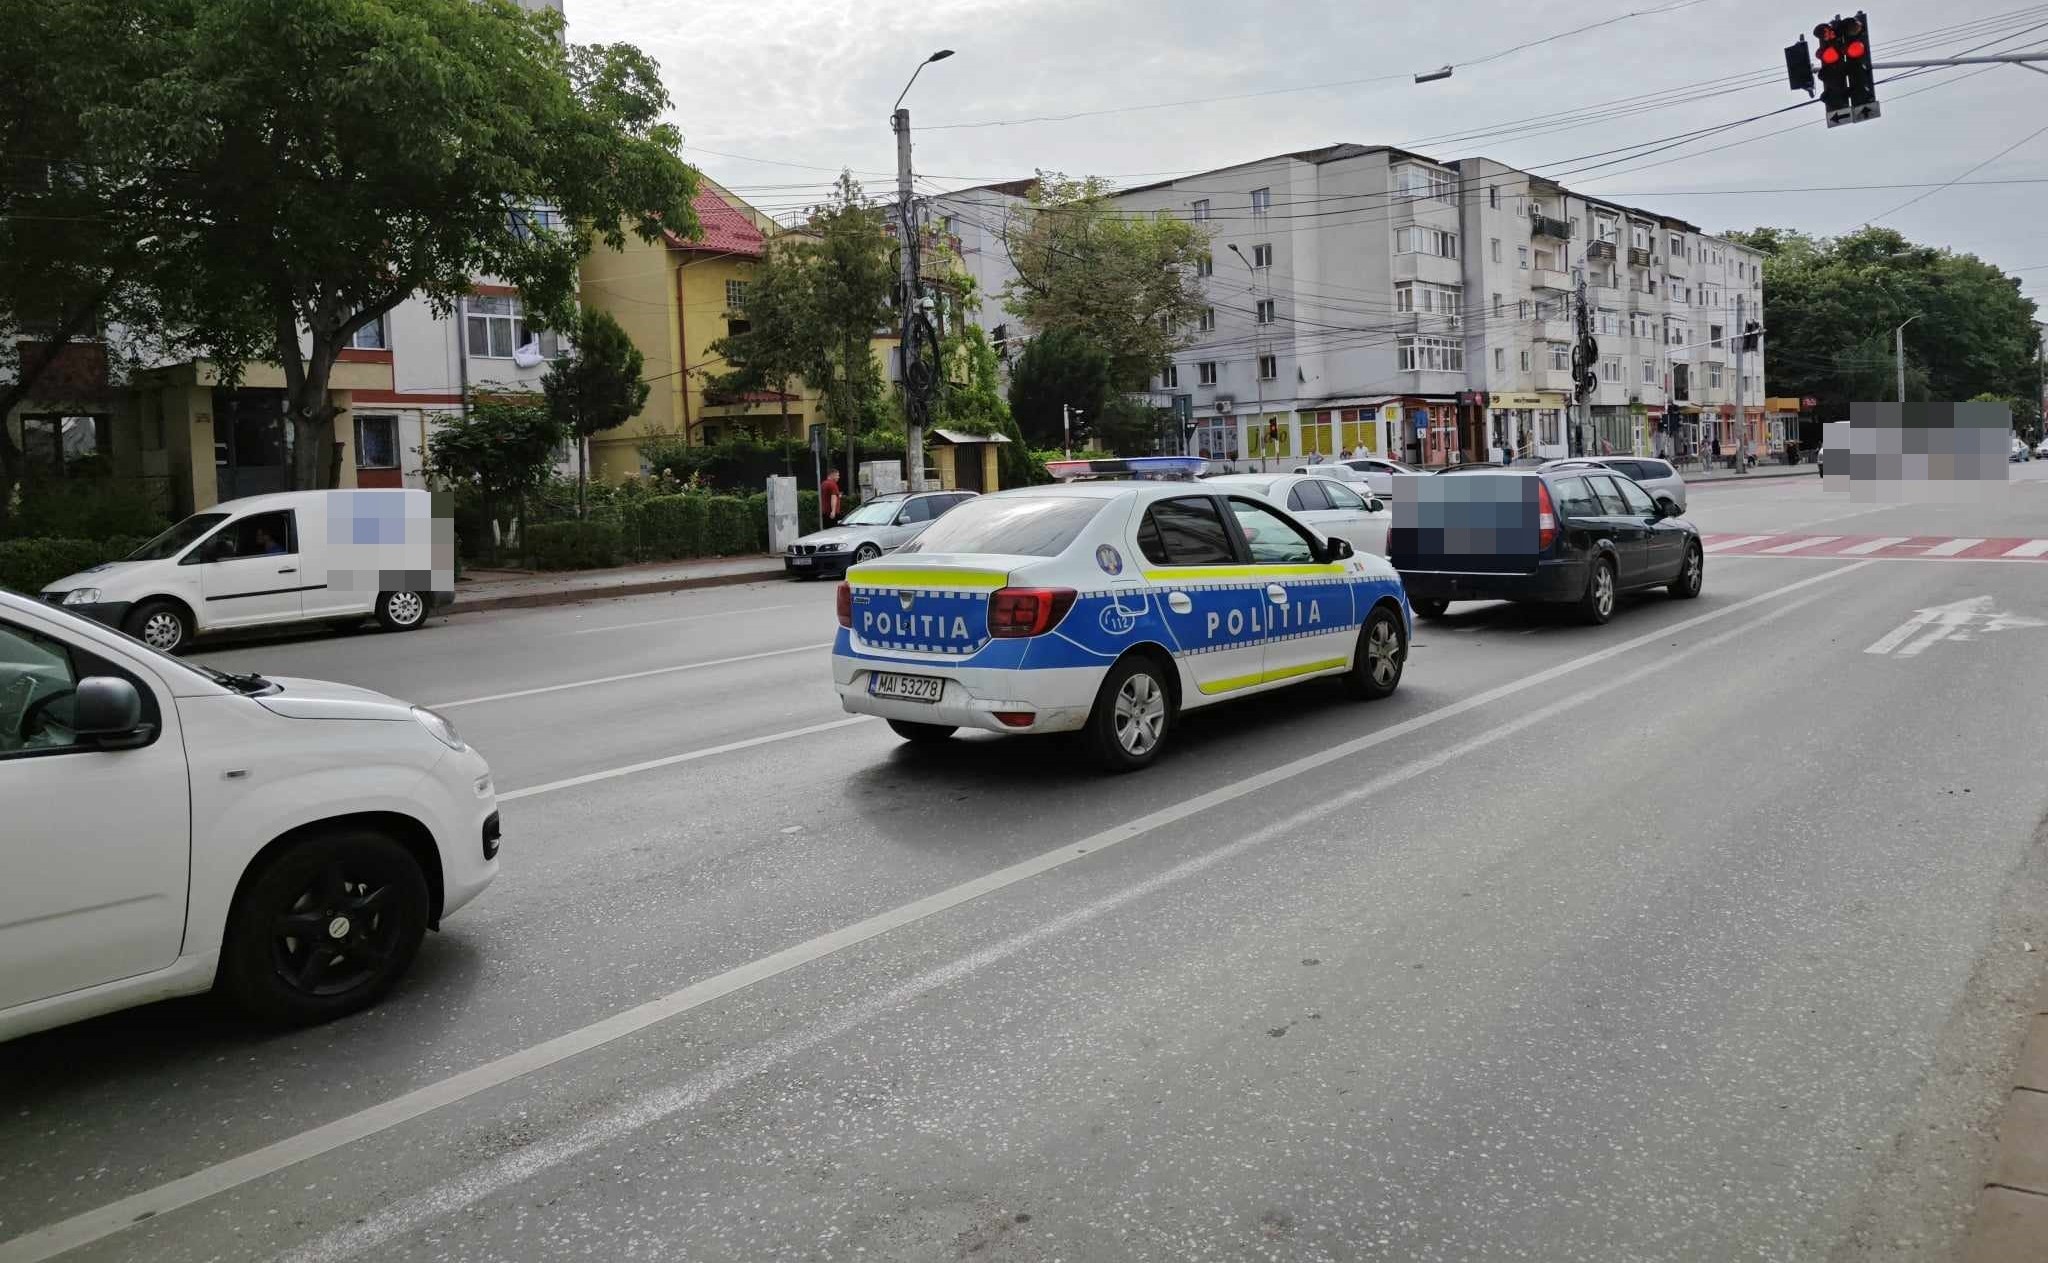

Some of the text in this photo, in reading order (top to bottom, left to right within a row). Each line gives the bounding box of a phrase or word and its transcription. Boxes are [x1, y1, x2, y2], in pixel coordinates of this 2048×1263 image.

[863, 611, 969, 639] POLITIA
[1111, 615, 1130, 630] 112
[1207, 599, 1321, 639] POLITIA
[879, 675, 898, 693] MAI
[900, 677, 939, 697] 53278
